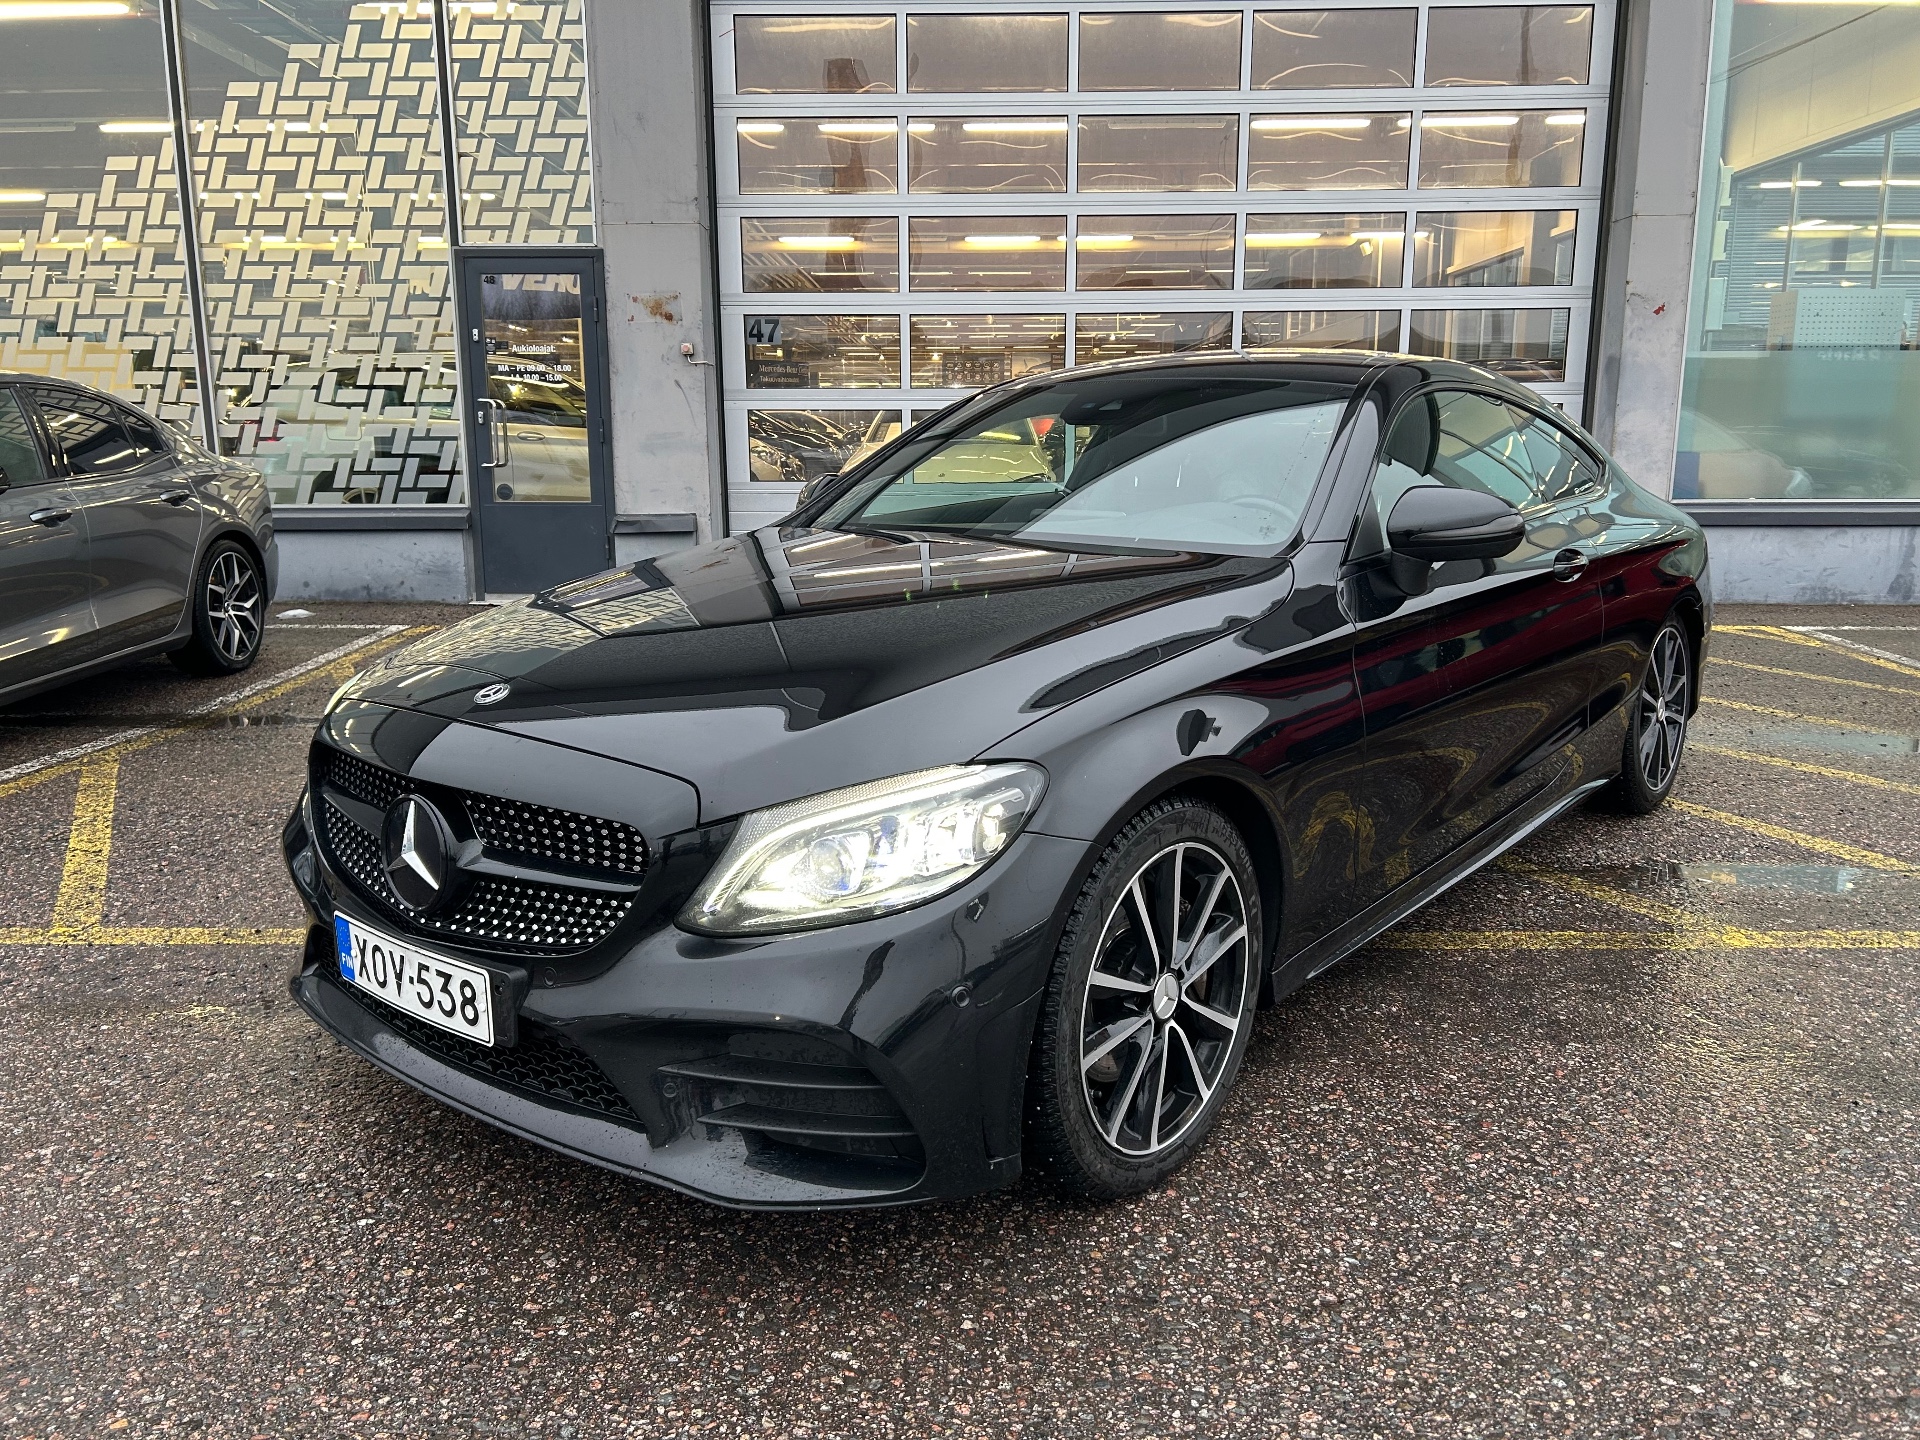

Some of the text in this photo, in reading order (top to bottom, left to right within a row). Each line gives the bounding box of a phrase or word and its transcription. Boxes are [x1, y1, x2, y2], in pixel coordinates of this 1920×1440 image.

[483, 275, 496, 285] 48
[748, 318, 780, 343] 47
[511, 344, 556, 353] Aukioloajat:
[497, 364, 510, 372] MA
[516, 364, 526, 372] PE
[526, 364, 546, 372] 09.00
[553, 364, 572, 372] 18.00
[545, 373, 562, 381] 15.00
[341, 951, 354, 970] FIN
[353, 933, 480, 1028] XOV-538
